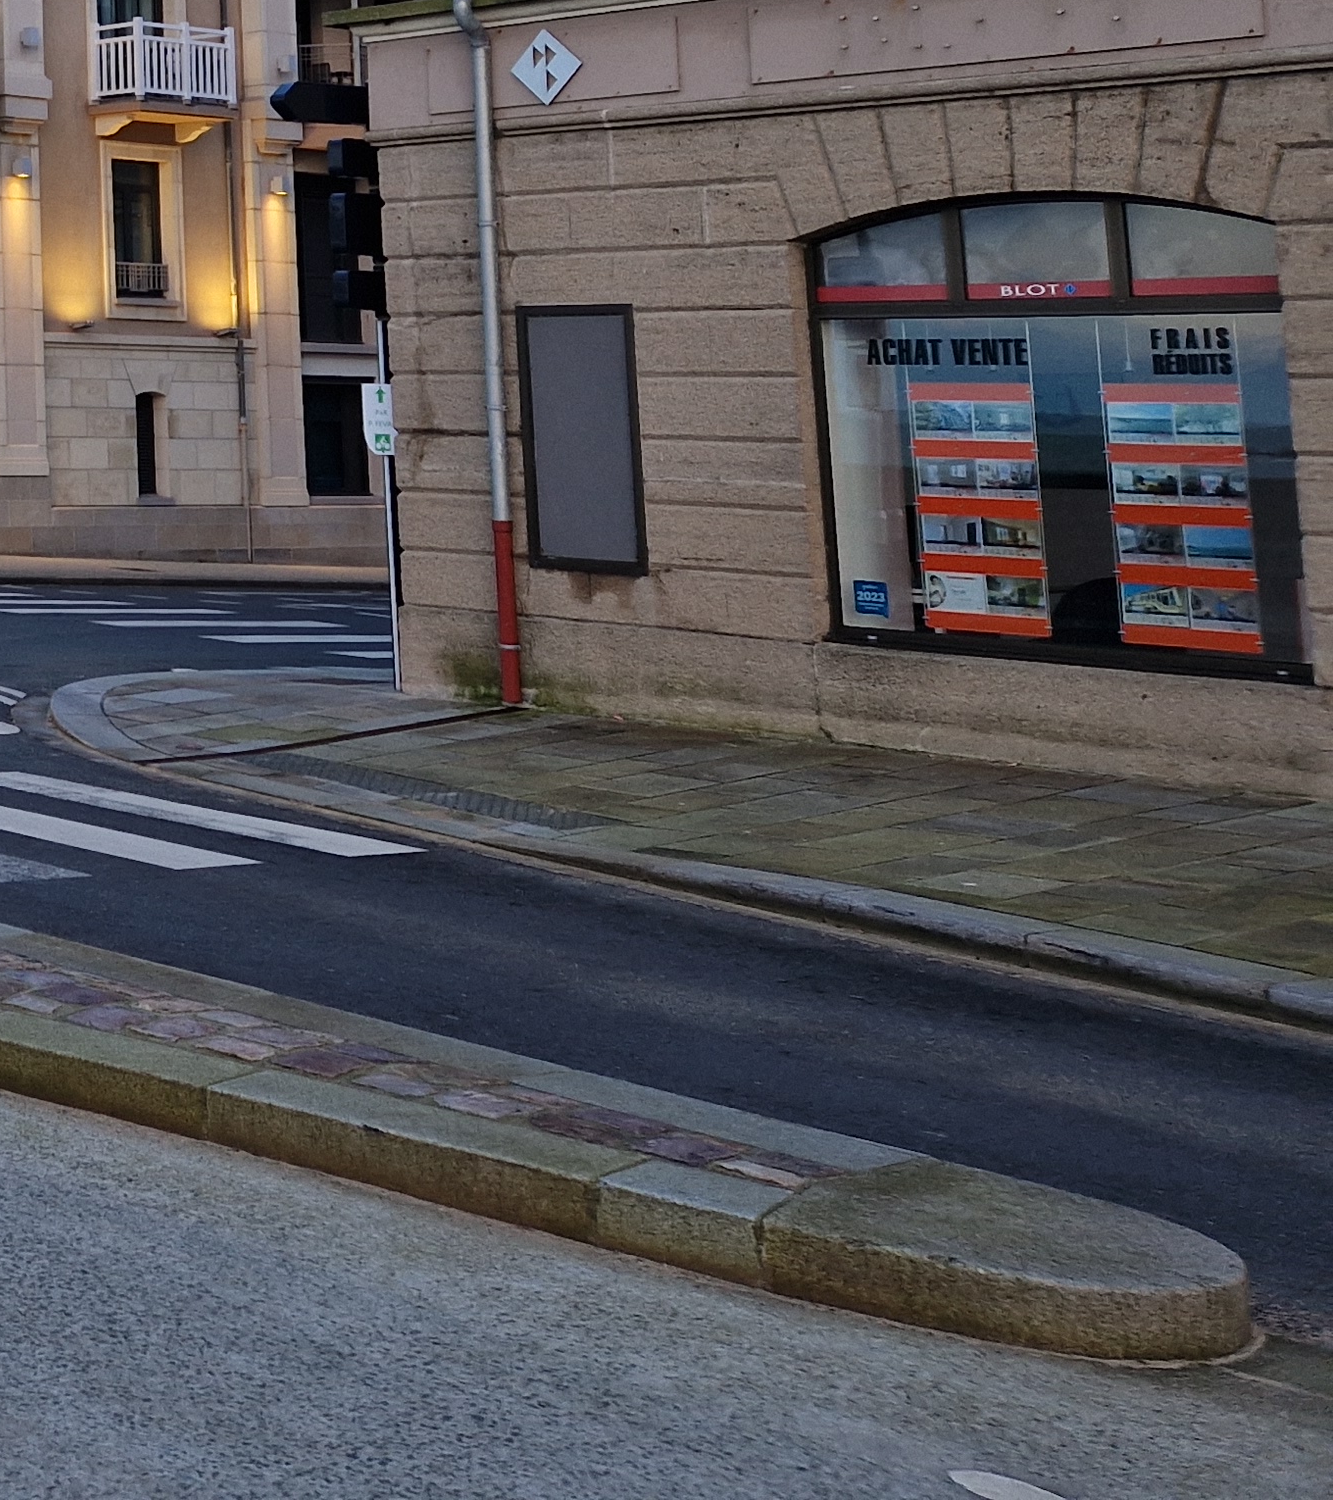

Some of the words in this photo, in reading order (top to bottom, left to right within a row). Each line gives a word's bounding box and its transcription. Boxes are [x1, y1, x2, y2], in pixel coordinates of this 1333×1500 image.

[1000, 284, 1060, 297] BLOT
[1150, 326, 1231, 350] FRAIS
[867, 338, 943, 366] ACHAT
[950, 337, 1029, 366] VENTE
[1153, 350, 1233, 375] RÉDUITS
[856, 590, 886, 603] 2023
